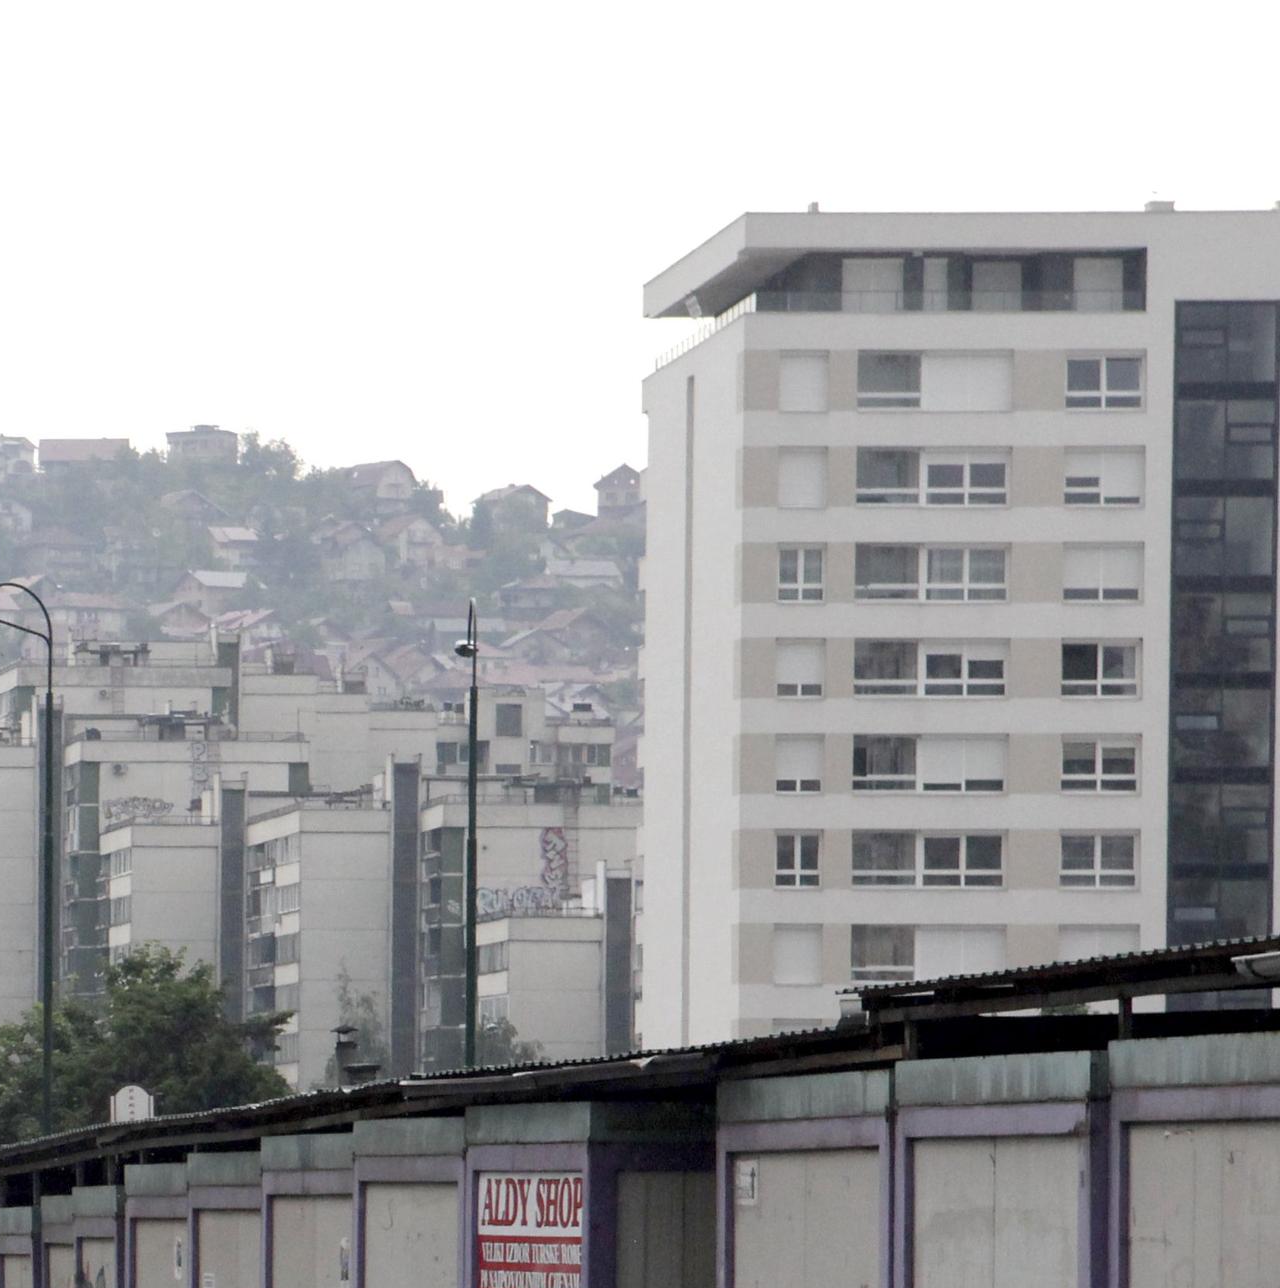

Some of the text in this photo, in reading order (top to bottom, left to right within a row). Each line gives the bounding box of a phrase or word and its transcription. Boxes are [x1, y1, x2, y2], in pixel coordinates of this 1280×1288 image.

[481, 1176, 584, 1228] ALDY SHOP
[482, 1241, 505, 1262] VELIKI
[506, 1242, 531, 1263] IZBOR
[532, 1243, 560, 1264] TURSKE
